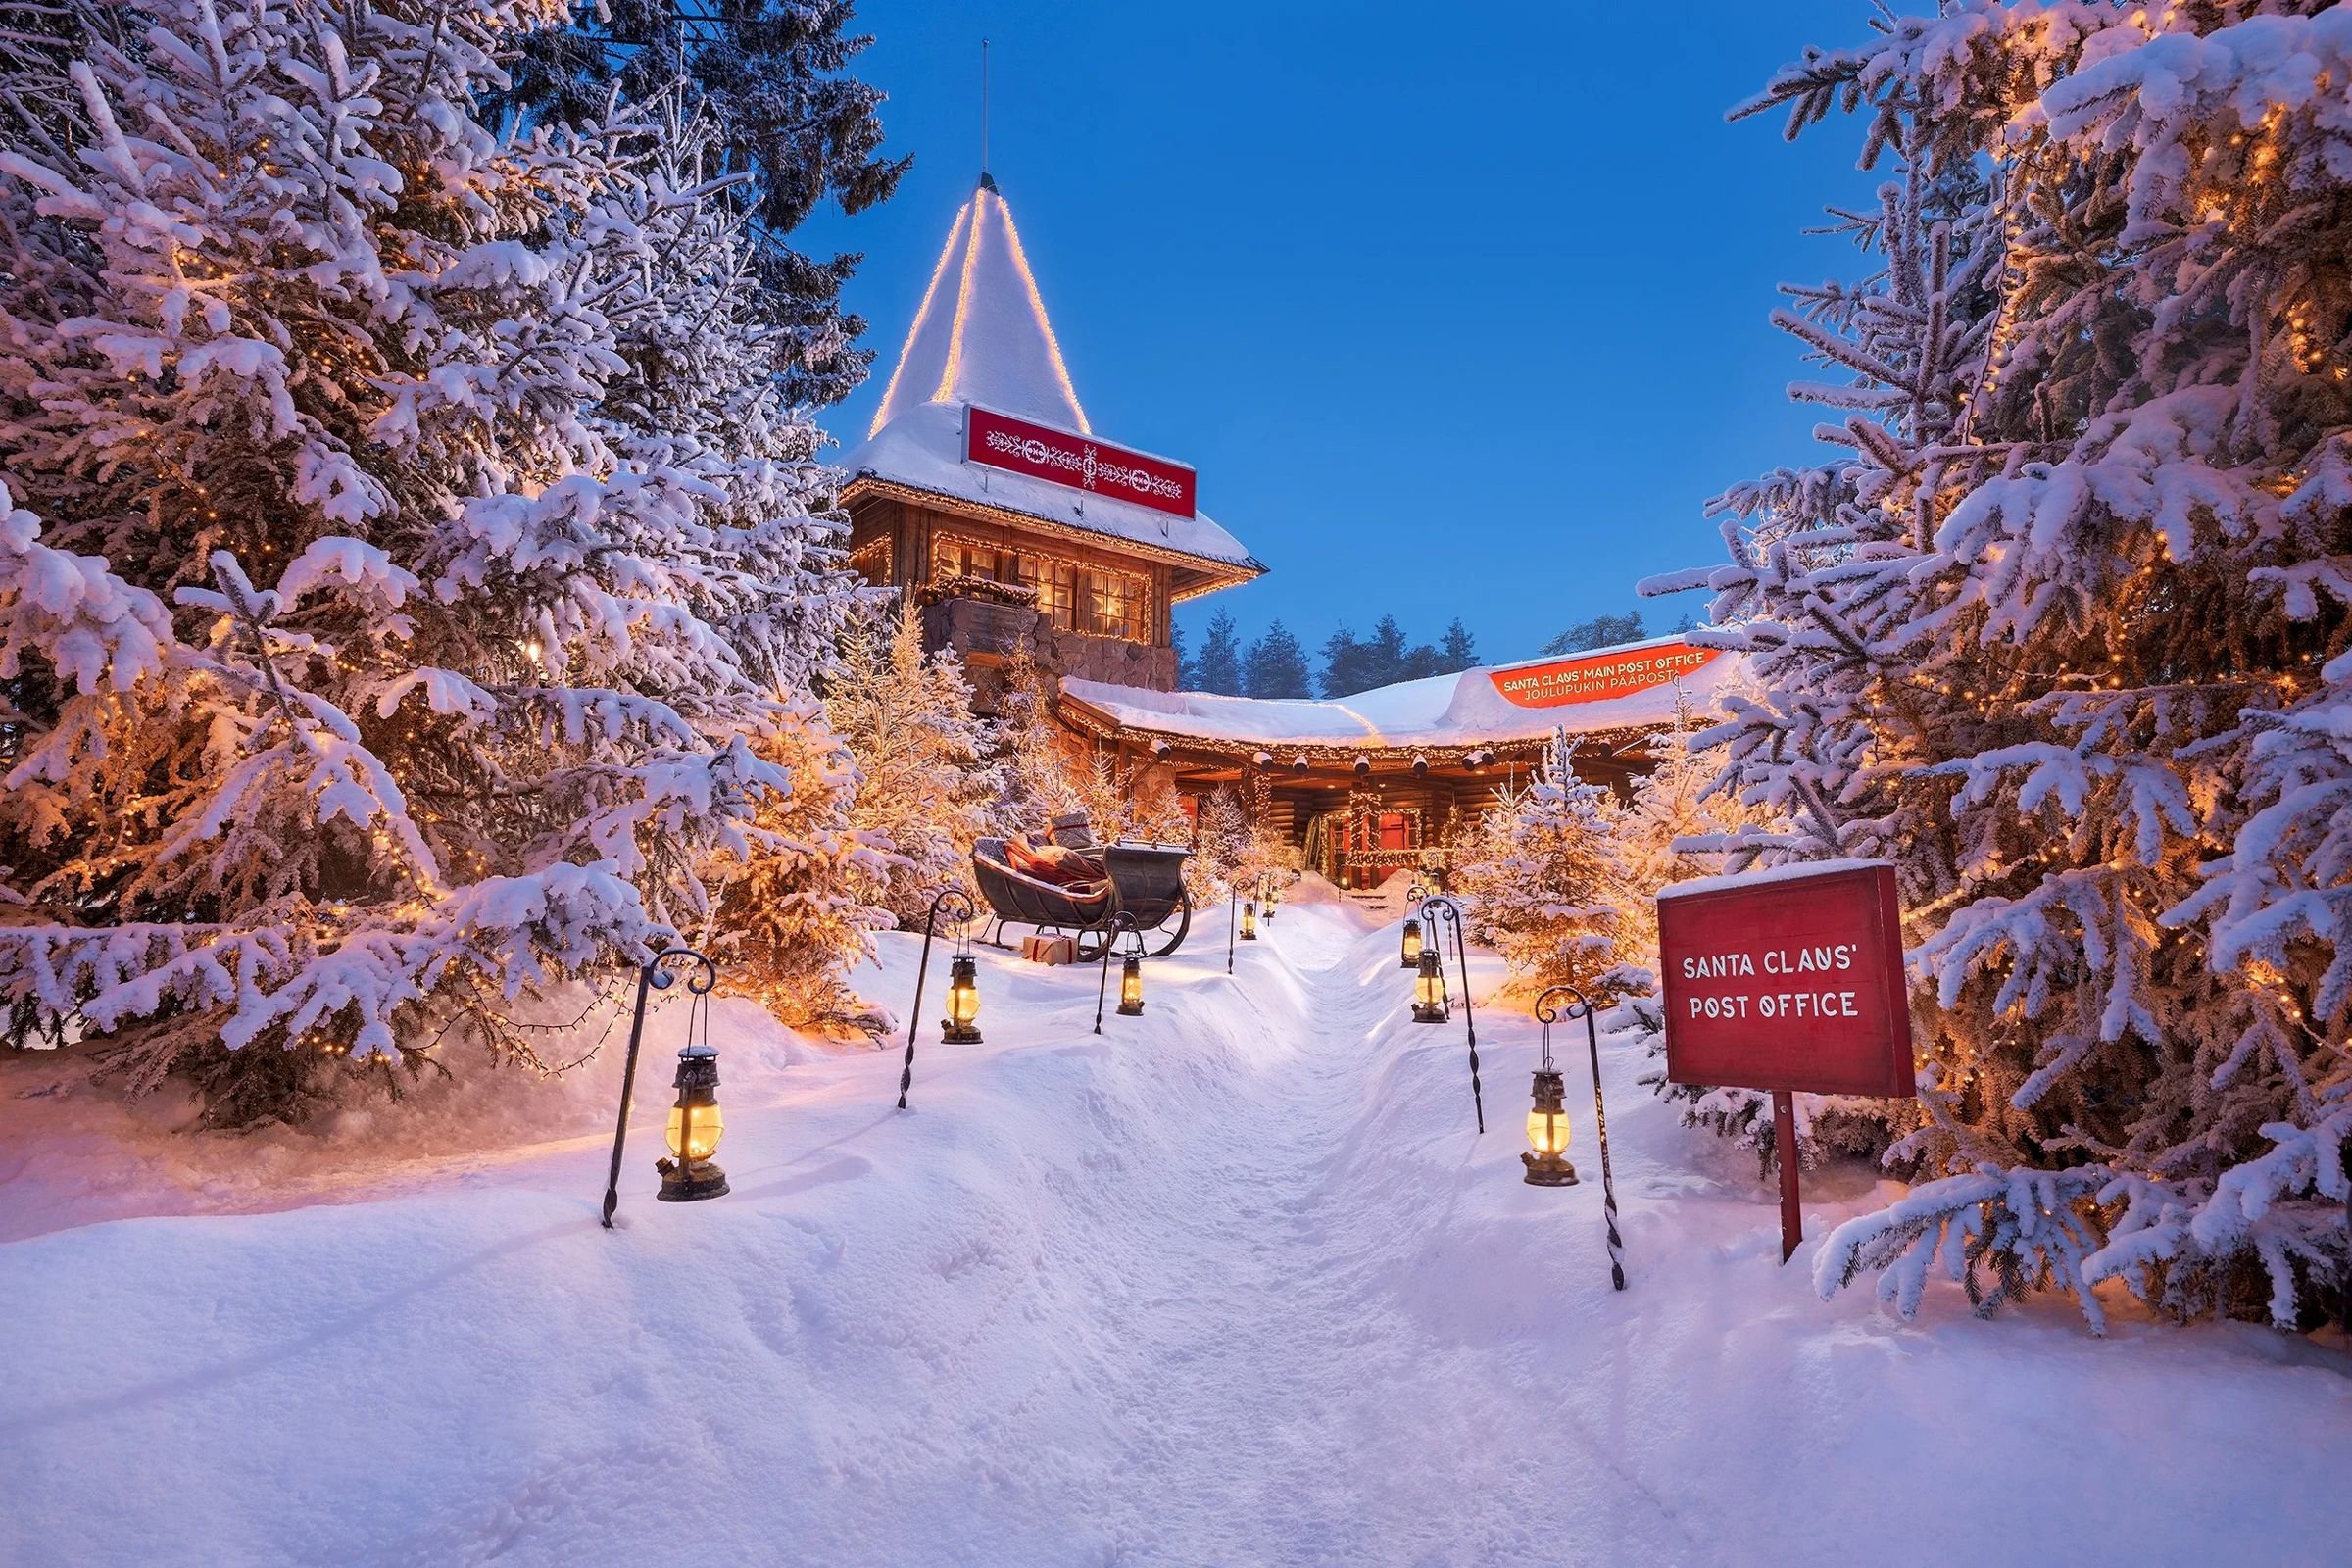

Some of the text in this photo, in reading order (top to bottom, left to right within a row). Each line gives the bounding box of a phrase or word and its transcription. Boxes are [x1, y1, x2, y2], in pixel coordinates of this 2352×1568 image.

[1504, 677, 1539, 692] SANTA
[1584, 665, 1615, 680] MAIN
[1617, 660, 1652, 675] POST
[1655, 652, 1705, 669] OFFICE
[1525, 679, 1605, 700] JOULUPUKIN
[1683, 944, 1857, 979] SANTA CLAUS'
[1690, 992, 1858, 1018] POST OFFICE
